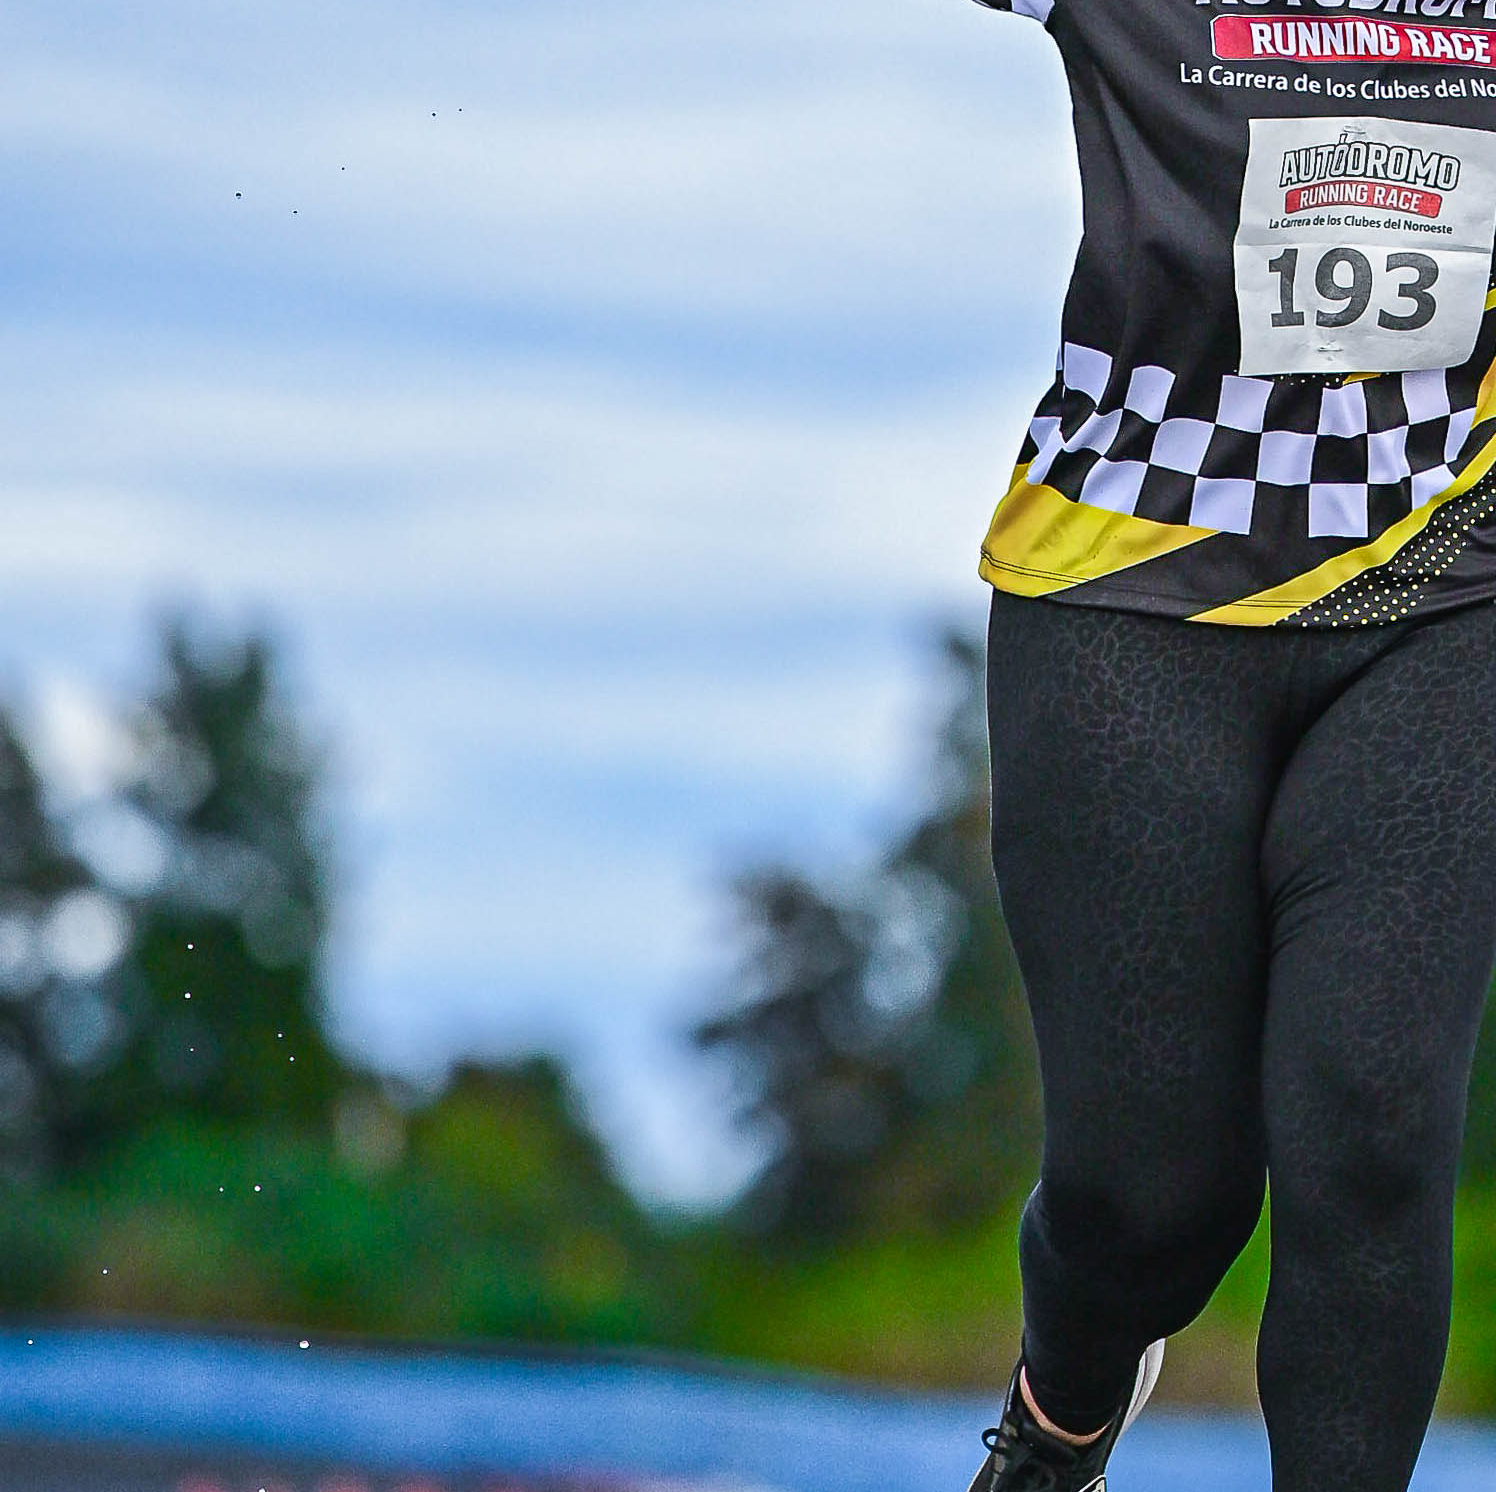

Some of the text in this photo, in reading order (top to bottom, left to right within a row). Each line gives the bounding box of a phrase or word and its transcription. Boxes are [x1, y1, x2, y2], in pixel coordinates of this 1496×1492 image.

[1250, 22, 1491, 63] RUNNING RACE
[1180, 63, 1202, 84] La
[1208, 65, 1288, 90] Carrera
[1293, 73, 1321, 93] de
[1326, 78, 1356, 98] los
[1360, 79, 1430, 99] Clubes
[1434, 78, 1466, 97] del
[1300, 183, 1422, 212] RUNNING RACE
[1268, 214, 1452, 235] La Carrera de los Clubes del Noroeste
[1268, 247, 1439, 331] 193
